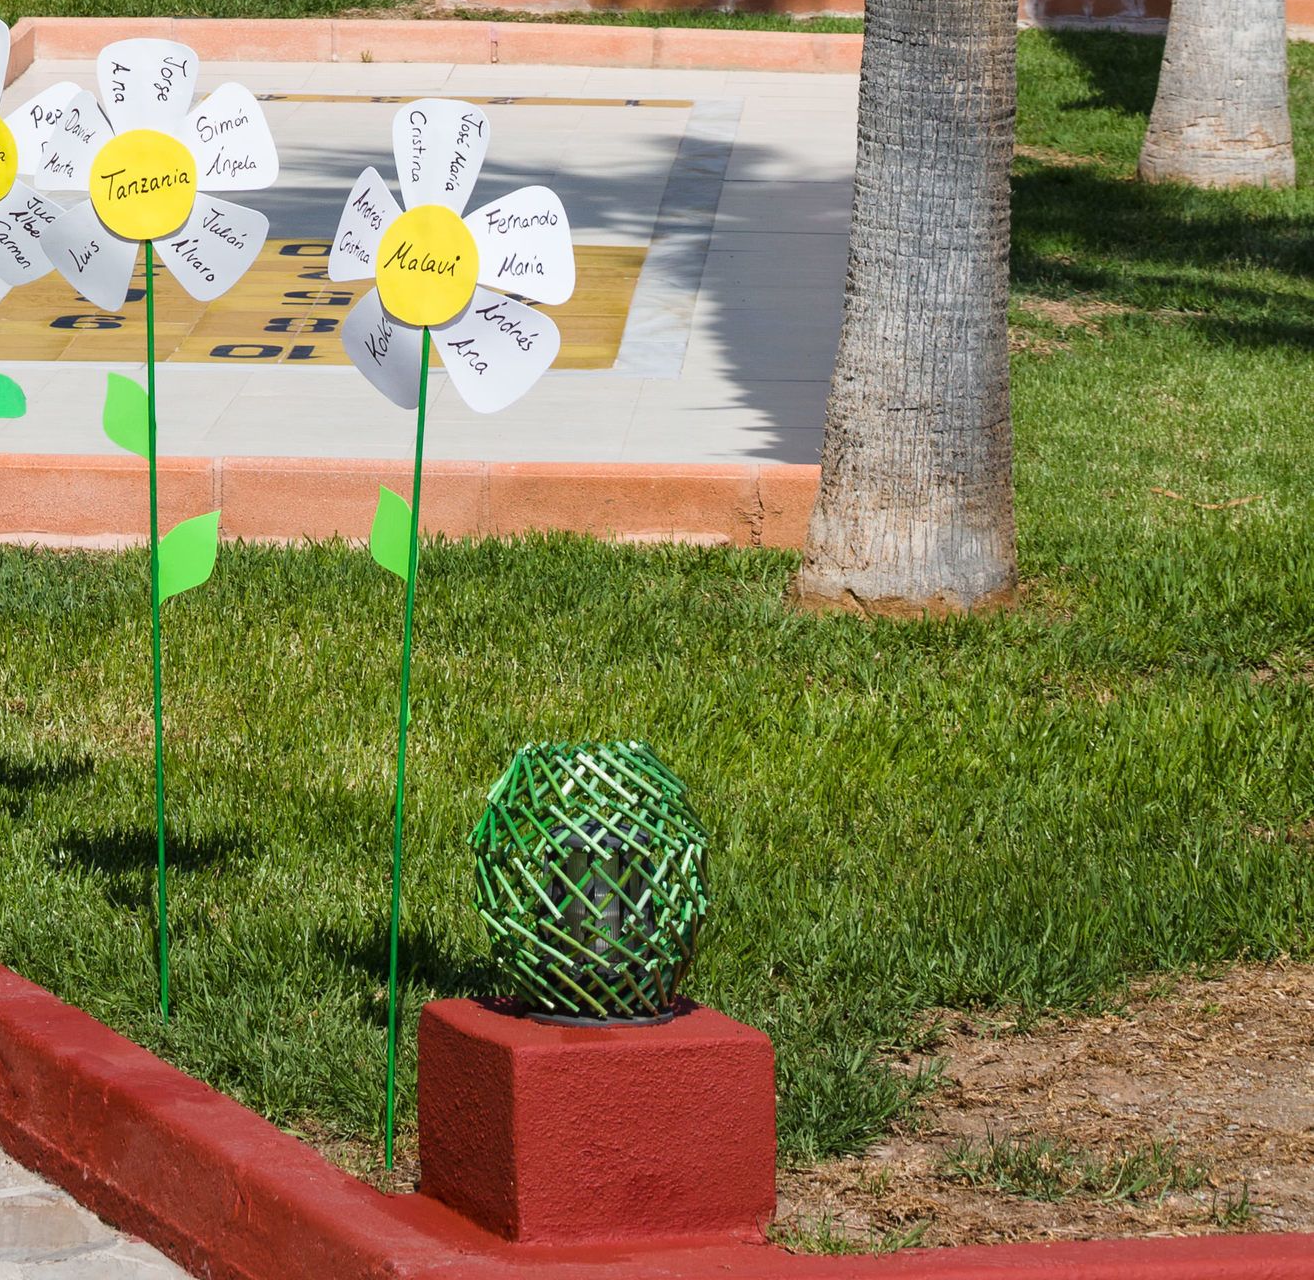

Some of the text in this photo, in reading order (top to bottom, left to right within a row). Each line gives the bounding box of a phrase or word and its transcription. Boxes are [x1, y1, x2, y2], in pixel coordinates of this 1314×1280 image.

[111, 61, 130, 104] Ana
[154, 56, 187, 102] Jorge
[65, 108, 96, 144] David
[196, 108, 249, 143] Simón
[454, 113, 484, 152] José
[44, 152, 74, 178] Marta
[206, 147, 257, 177] Ángela
[409, 110, 427, 183] Cristina
[101, 169, 190, 201] Tanzania
[352, 187, 383, 232] Andrés
[486, 208, 557, 234] Fernando
[203, 208, 246, 250] Julián
[68, 240, 100, 274] Luis
[171, 239, 216, 282] Álvaro
[339, 231, 370, 265] Cristina
[447, 337, 488, 375] Ana
